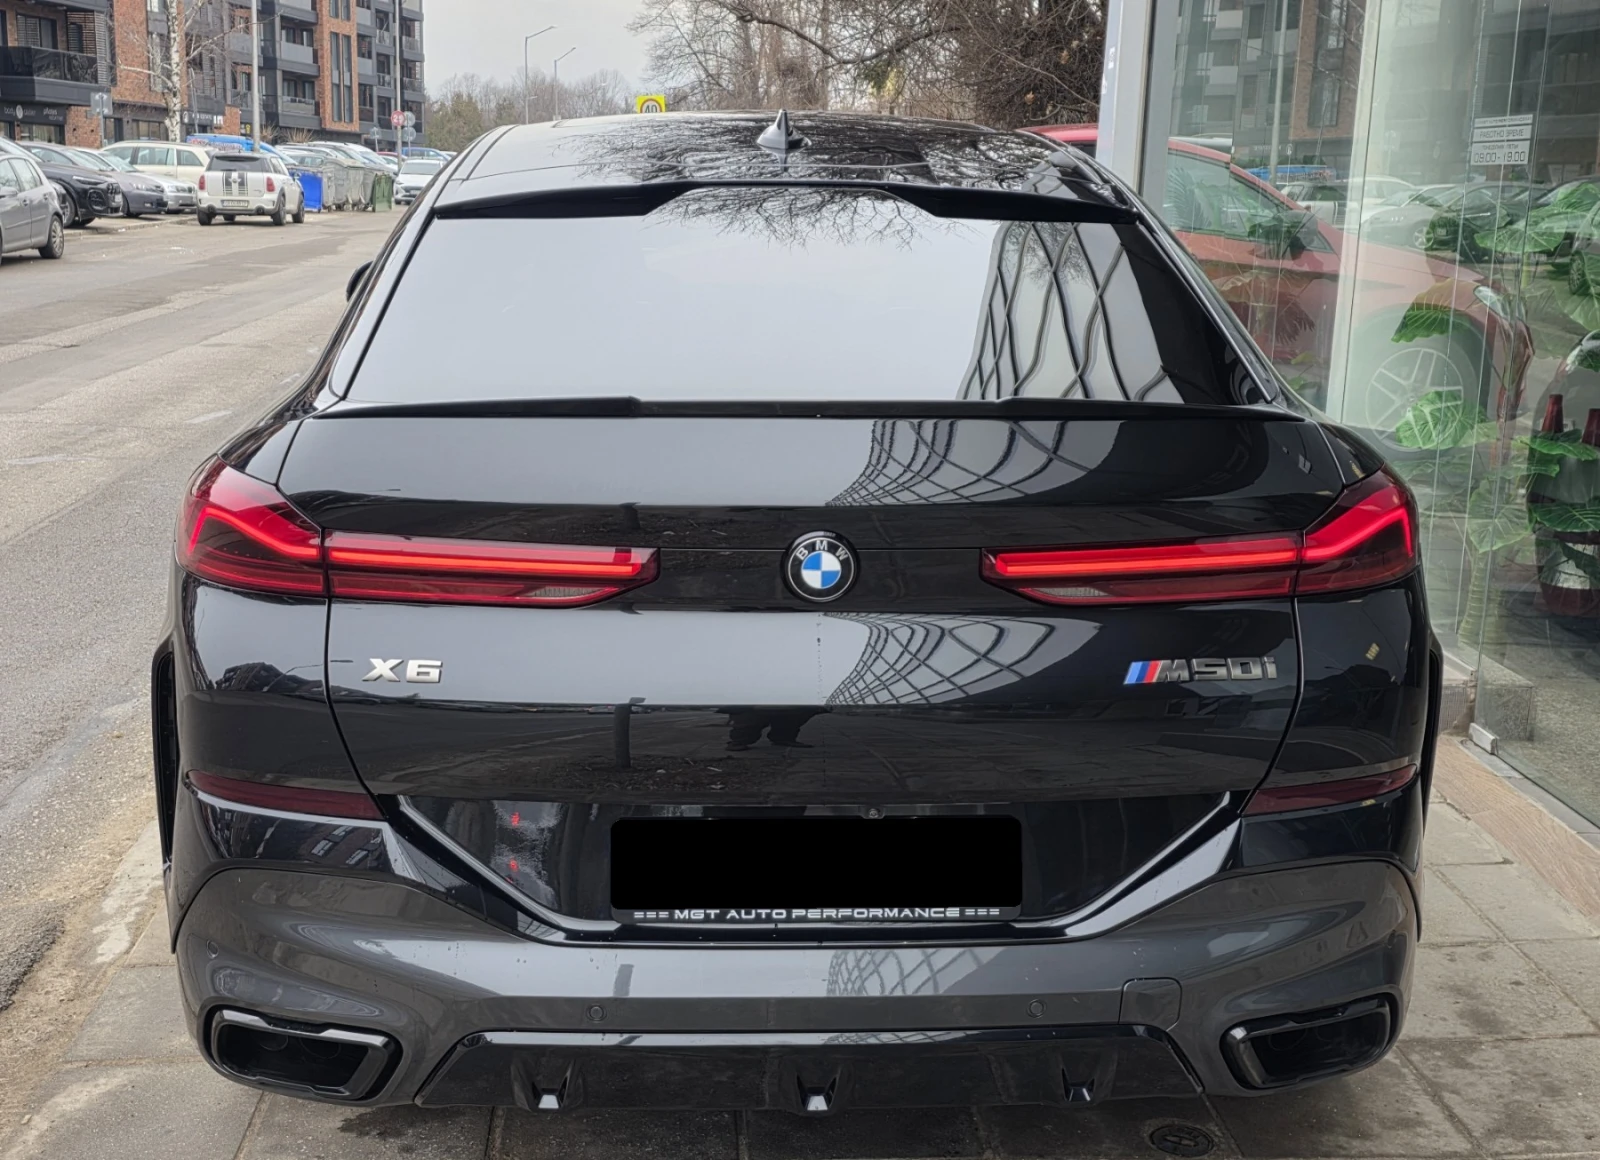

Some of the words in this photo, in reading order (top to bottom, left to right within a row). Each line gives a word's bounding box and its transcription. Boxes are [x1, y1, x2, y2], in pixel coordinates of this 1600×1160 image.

[795, 539, 849, 561] BMW
[362, 657, 443, 684] X6
[674, 909, 720, 919] MGT
[726, 909, 787, 919] AUTO
[792, 907, 960, 919] PERFORMANCE
